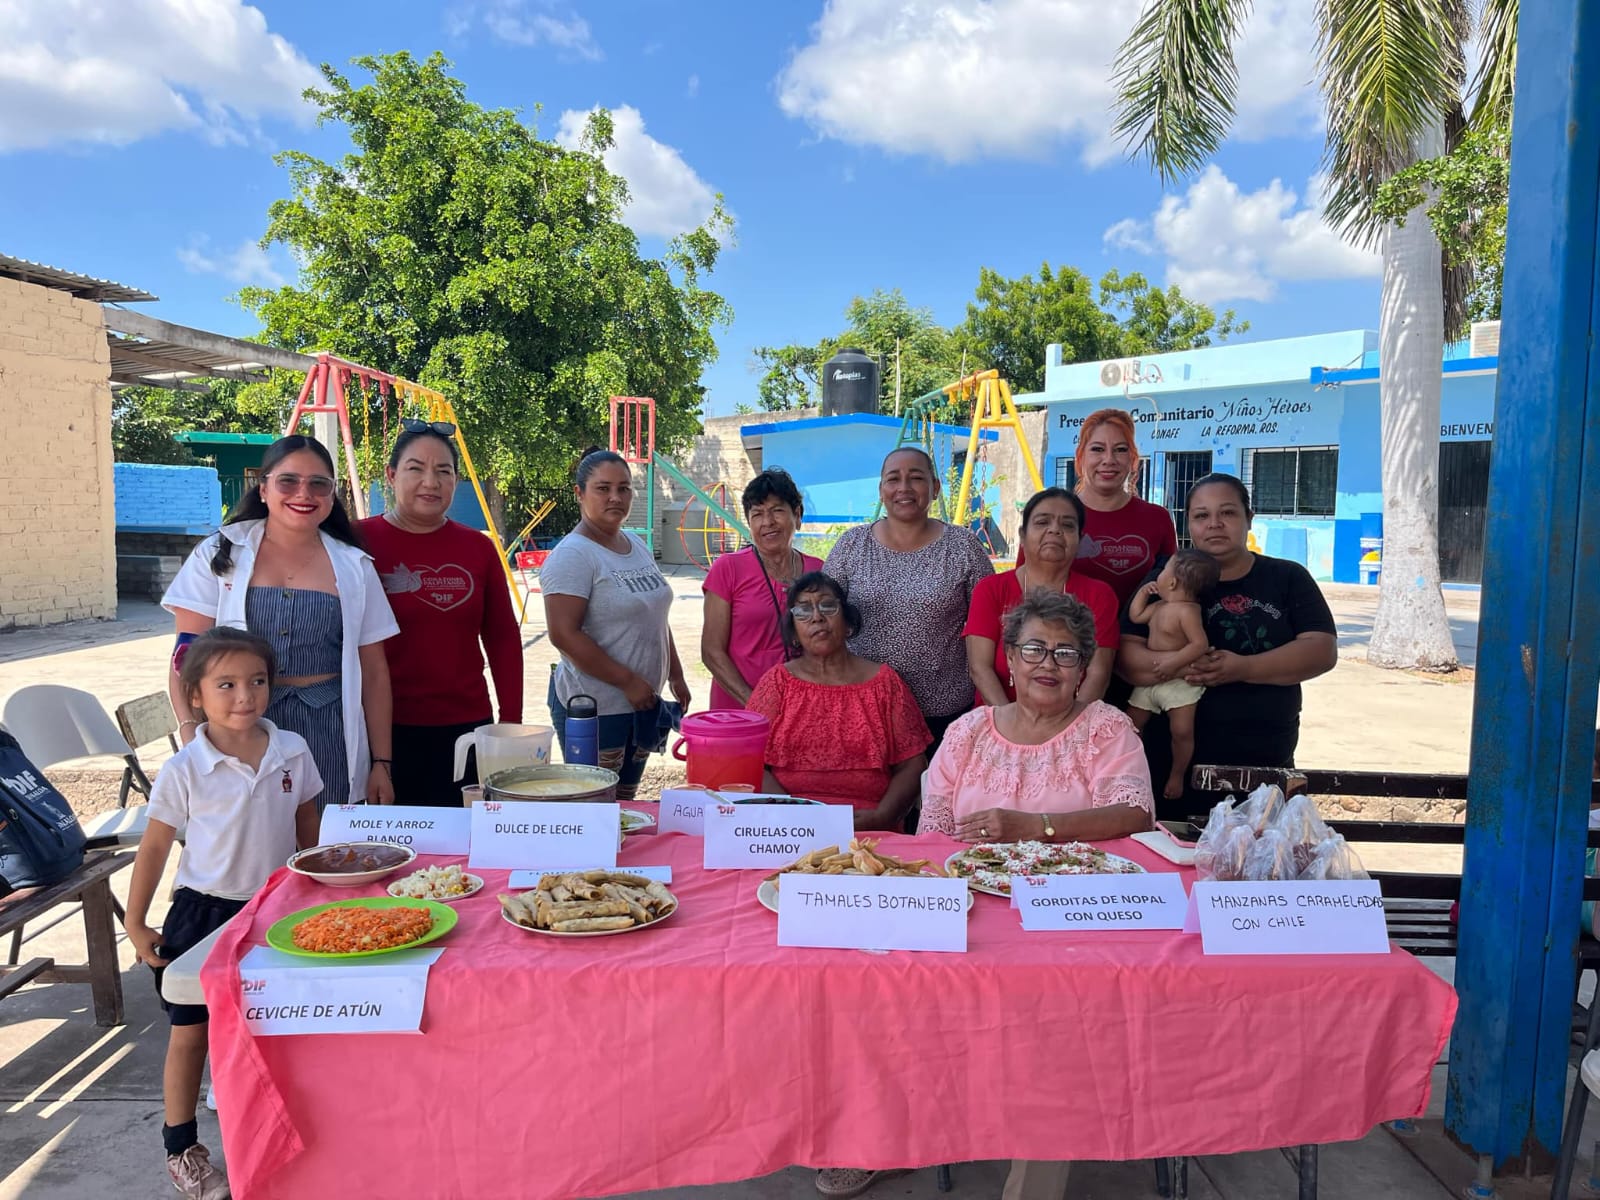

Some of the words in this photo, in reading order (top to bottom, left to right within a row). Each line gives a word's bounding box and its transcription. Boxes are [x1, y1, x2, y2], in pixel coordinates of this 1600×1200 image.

[1130, 405, 1214, 423] Comunitario
[1215, 398, 1263, 422] Niños
[1151, 428, 1180, 439] CONAFE
[1201, 426, 1211, 437] LA
[1440, 423, 1493, 436] BIENVEN
[673, 804, 704, 817] AGUA
[349, 820, 382, 829] MOLE
[383, 820, 392, 829] Y
[395, 820, 435, 829] ARROZ
[495, 824, 529, 834] DULCE
[532, 824, 547, 834] DE
[549, 825, 584, 835] LECHE
[734, 827, 788, 837] CIRUELAS
[790, 827, 815, 838] CON
[749, 844, 801, 854] CHAMOY
[797, 891, 872, 908] TAMALES
[878, 894, 961, 912] BOTANEROS
[1031, 896, 1098, 907] GORDITAS
[1101, 895, 1118, 904] DE
[1122, 895, 1167, 904] NOPAL
[1211, 895, 1288, 909] MANZANAS
[1064, 912, 1094, 921] CON
[1096, 911, 1143, 921] QUESO
[1232, 917, 1260, 930] CON
[1268, 916, 1306, 928] CHILE
[246, 1005, 309, 1020] CEVICHE
[313, 1005, 335, 1018] DE
[337, 1001, 382, 1017] ATÚN
